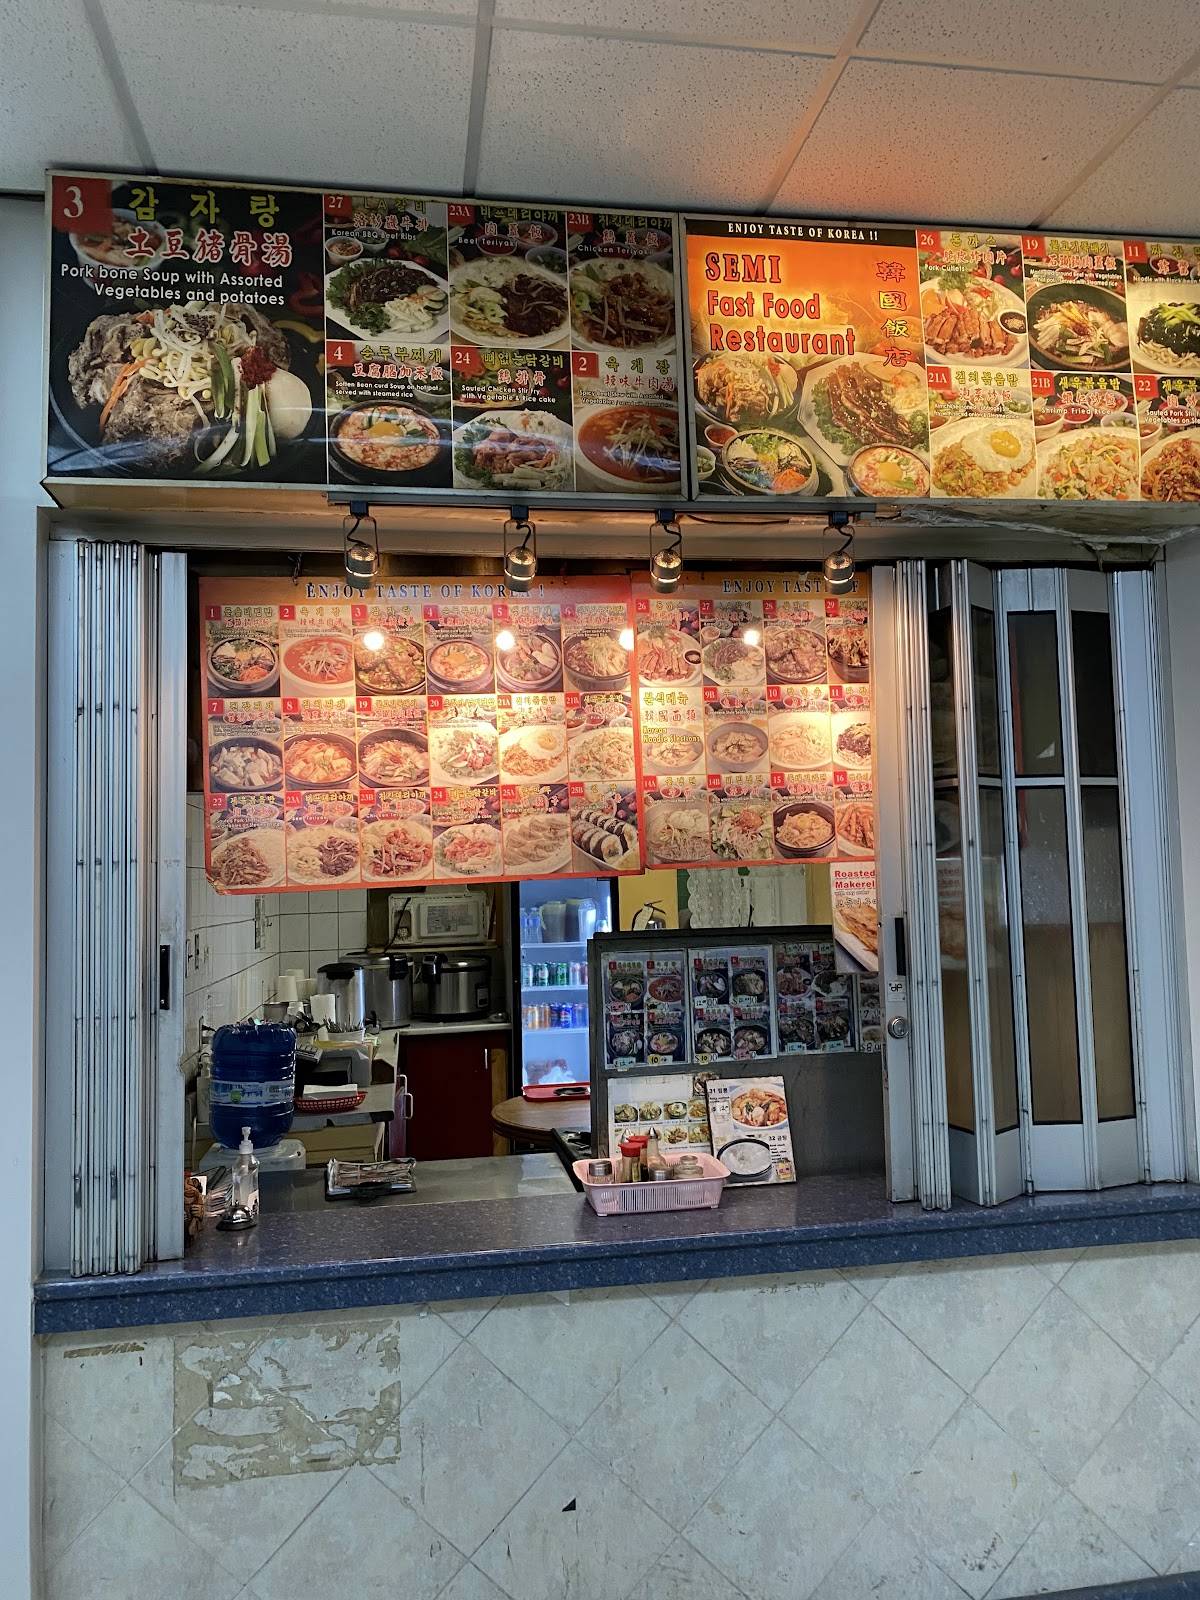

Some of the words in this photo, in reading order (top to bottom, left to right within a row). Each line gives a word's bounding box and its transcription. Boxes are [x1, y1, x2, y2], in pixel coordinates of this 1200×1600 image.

[63, 186, 84, 218] 3
[328, 196, 344, 208] 27
[449, 205, 471, 217] 23A
[332, 229, 360, 237] Korean
[362, 231, 378, 239] BBQ
[400, 232, 417, 241] Ribs
[728, 223, 763, 234] ENJOY
[769, 225, 803, 236] TASTE
[809, 227, 822, 237] OF
[828, 228, 865, 240] KOREA
[458, 237, 478, 245] Beef
[920, 234, 934, 245] 26
[1026, 239, 1038, 250] 19
[577, 244, 614, 253] Chicken
[1127, 245, 1139, 257] 11
[705, 252, 782, 284] SEMI
[925, 263, 939, 271] Pork
[61, 263, 94, 279] Pork
[99, 265, 138, 280] bone
[143, 267, 180, 284] Soup
[185, 270, 215, 285] with
[220, 273, 284, 288] Assorted
[95, 283, 181, 301] Vegetables
[186, 287, 215, 303] and
[220, 291, 285, 307] potatoes
[707, 290, 755, 318] Fast
[763, 292, 821, 320] Food
[875, 260, 911, 368] 韓國飯店
[709, 323, 856, 356] Restaurant
[333, 346, 344, 361] 4
[455, 352, 471, 364] 24
[579, 356, 587, 371] 2
[928, 373, 947, 383] 21A
[1032, 378, 1051, 388] 21B
[390, 383, 405, 391] Soup
[487, 385, 517, 393] Chicken
[1138, 380, 1151, 391] 22
[1041, 407, 1068, 416] Shrimp
[307, 584, 365, 598] ENJOY
[376, 584, 432, 598] TASTE
[440, 584, 462, 598] OF
[723, 580, 776, 593] ENJOY
[783, 580, 826, 593] TAST
[701, 602, 710, 611] 27
[827, 601, 835, 609] 29
[283, 608, 289, 617] 2
[355, 607, 361, 617] 3
[497, 607, 503, 616] 5
[643, 692, 690, 706] 분식메뉴
[704, 690, 715, 699] 9B
[769, 690, 778, 698] 10
[212, 702, 218, 711] 7
[287, 701, 293, 710] 8
[359, 700, 368, 709] 19
[430, 699, 439, 707] 20
[643, 726, 668, 735] Korean
[643, 735, 669, 744] Noodle
[773, 776, 782, 784] 15
[836, 774, 845, 782] 16
[433, 790, 443, 799] 24
[834, 870, 876, 878] Roasted
